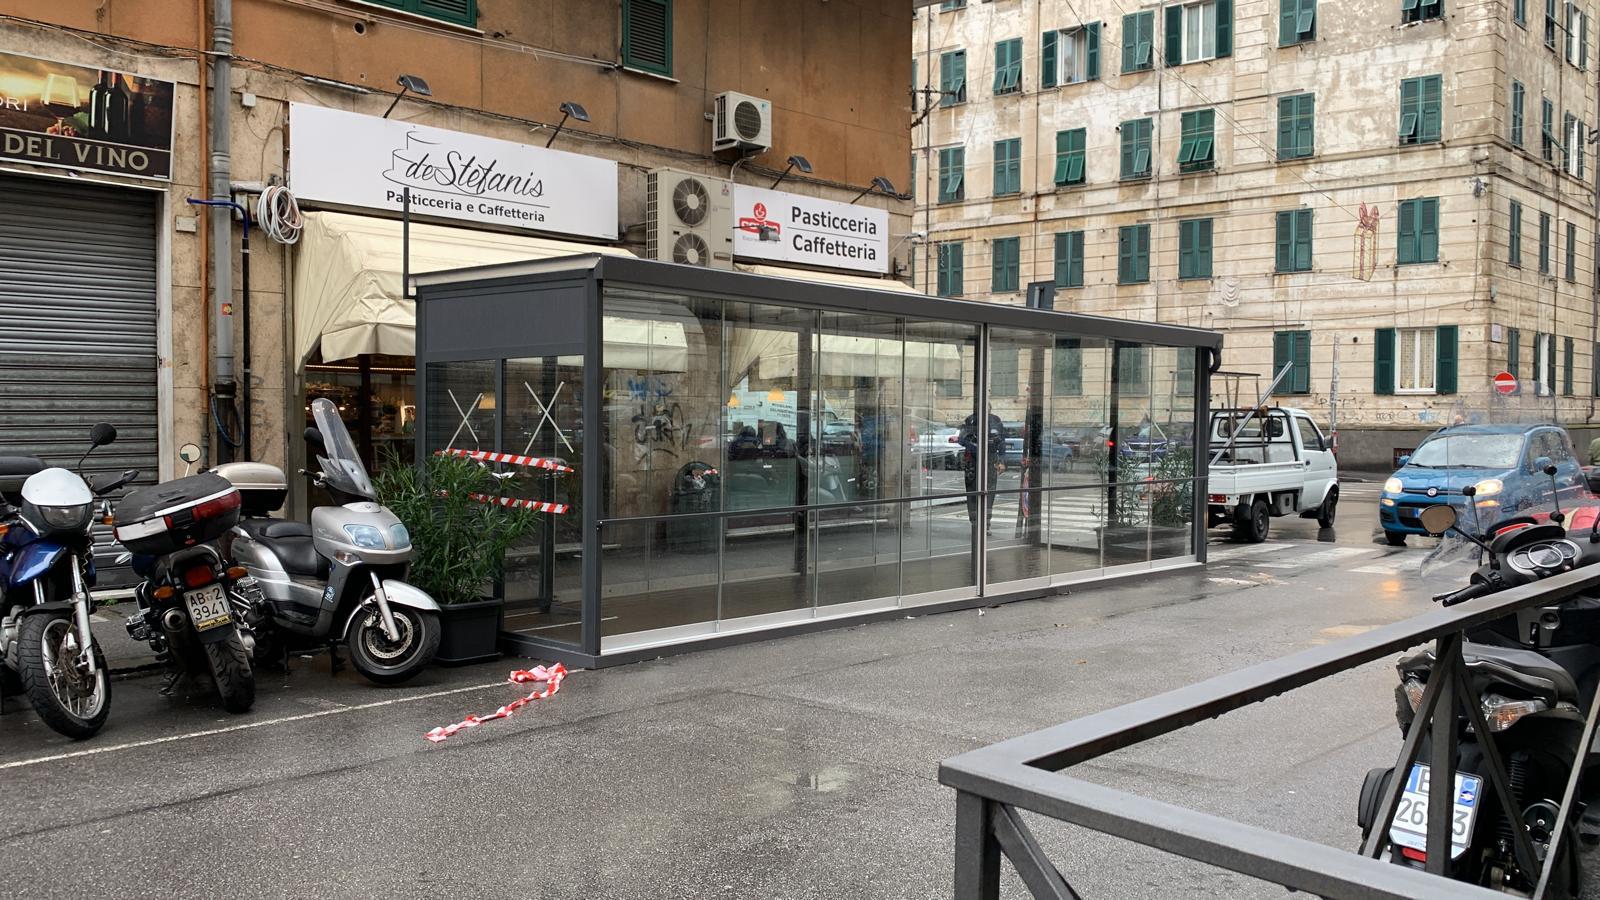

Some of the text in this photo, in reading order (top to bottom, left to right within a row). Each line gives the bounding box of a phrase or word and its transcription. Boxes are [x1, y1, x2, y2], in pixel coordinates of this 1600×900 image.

[4, 133, 149, 171] DEL VINO
[466, 203, 475, 213] e
[478, 204, 545, 222] Caffetteria
[791, 206, 877, 235] Pasticceria
[792, 234, 877, 261] Caffetteria
[193, 601, 226, 620] 3941
